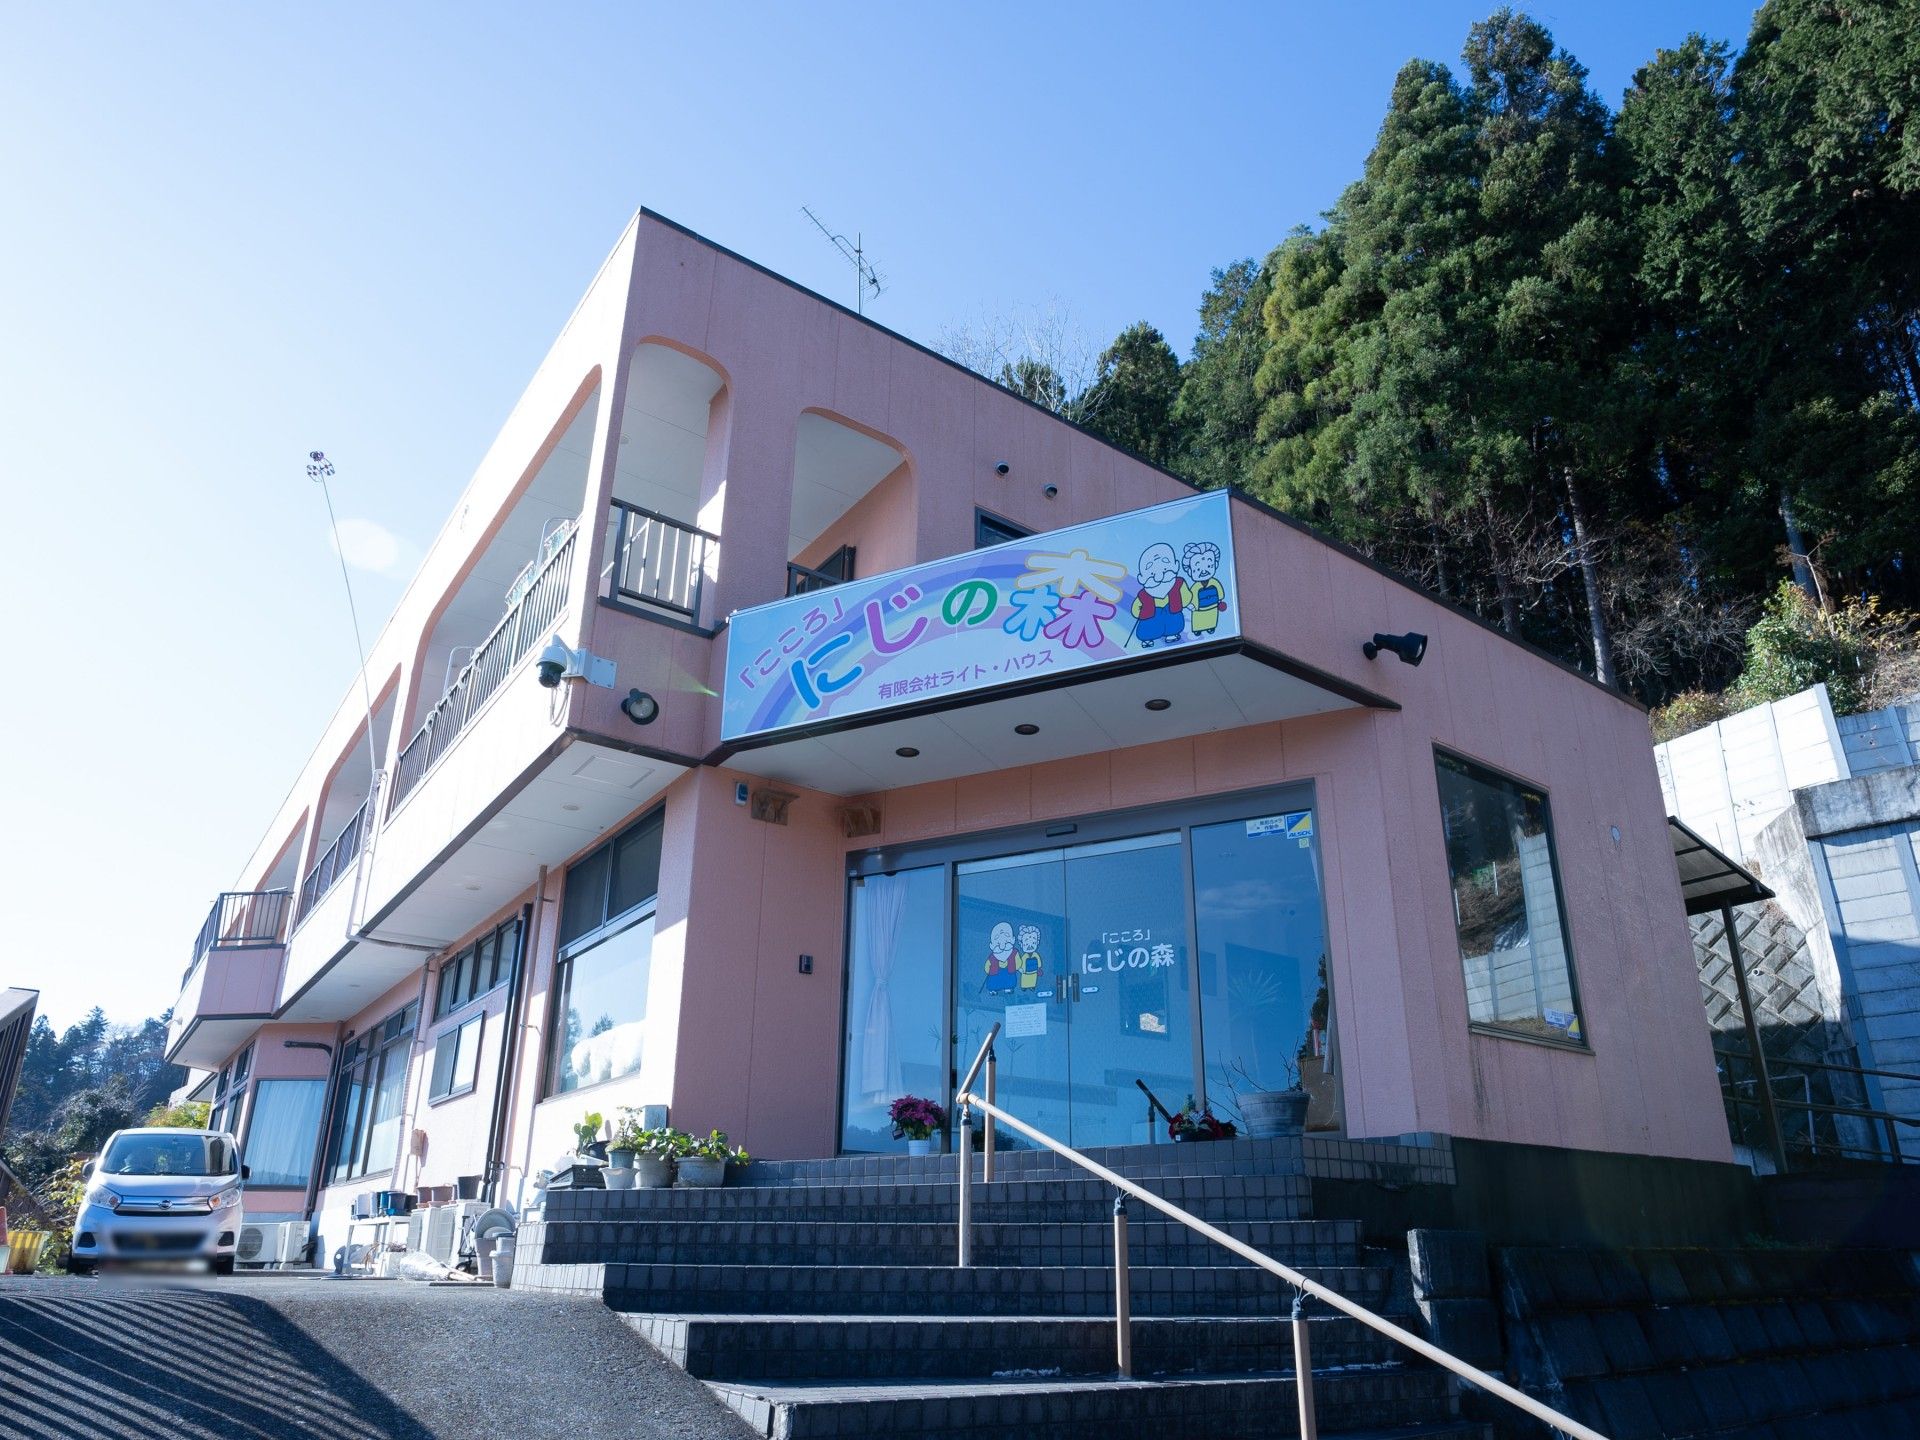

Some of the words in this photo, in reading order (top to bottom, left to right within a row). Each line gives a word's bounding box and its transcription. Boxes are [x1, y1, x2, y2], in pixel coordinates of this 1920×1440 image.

[739, 597, 844, 689] 「こころ」
[791, 548, 1127, 709] にじの森
[878, 650, 1054, 699] 有限会社ライト・ハウス
[1082, 943, 1175, 975] にじの森
[1102, 929, 1151, 944] 「こころ」
